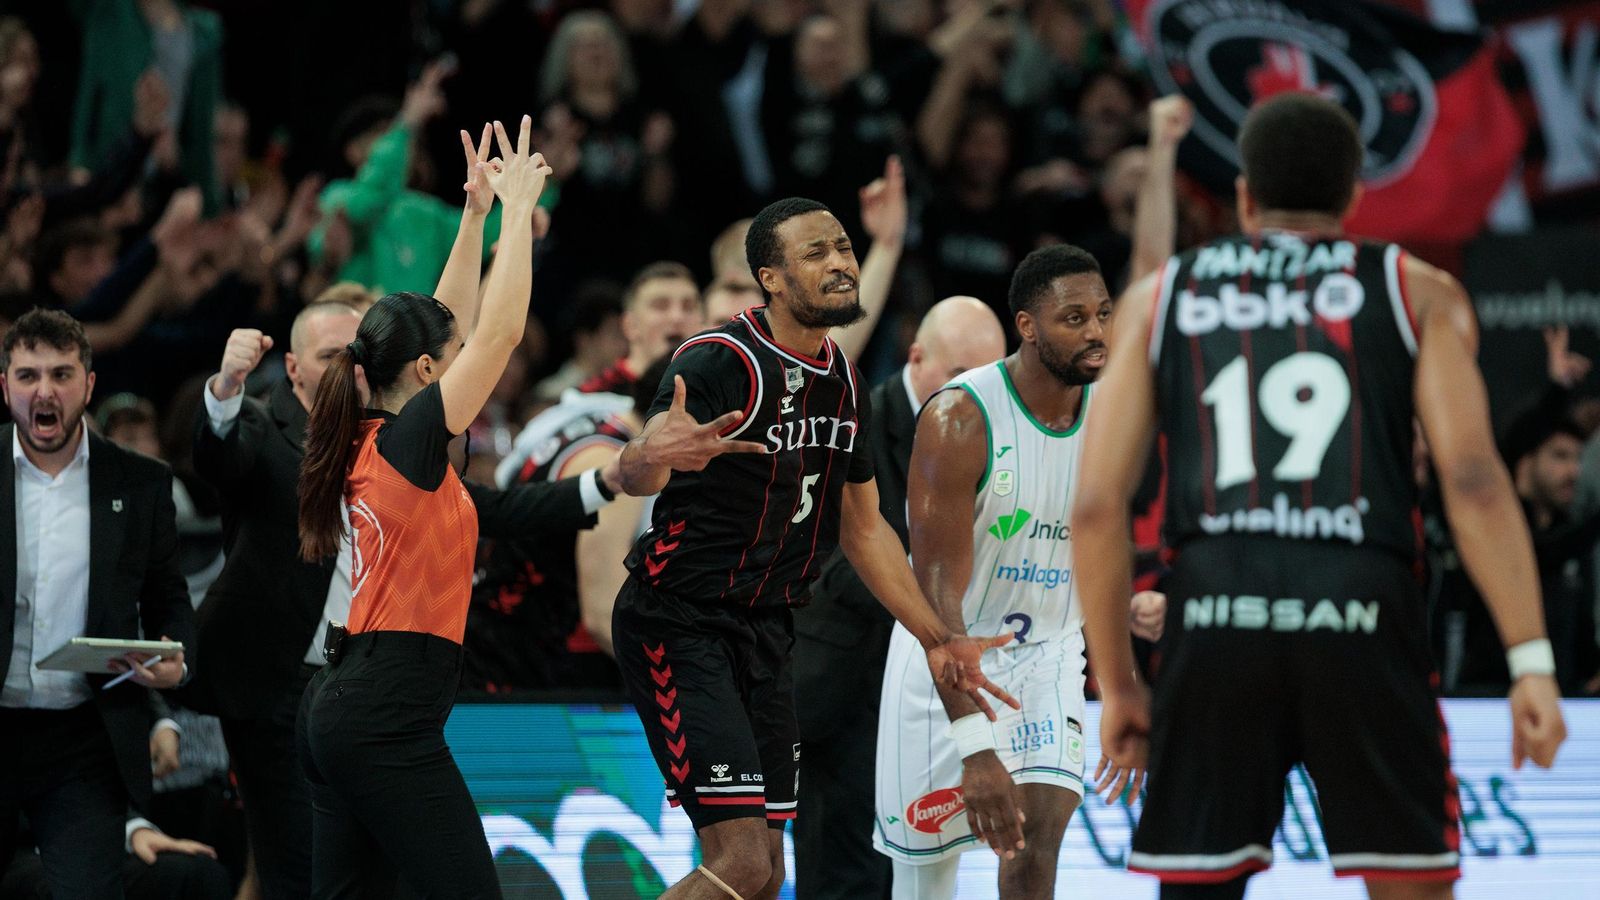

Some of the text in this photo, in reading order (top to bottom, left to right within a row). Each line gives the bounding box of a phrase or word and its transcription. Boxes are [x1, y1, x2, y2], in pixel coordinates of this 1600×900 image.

[1201, 353, 1350, 490] 19
[791, 473, 820, 523] 5
[1004, 612, 1033, 645] 3
[1183, 594, 1380, 635] NISSAN
